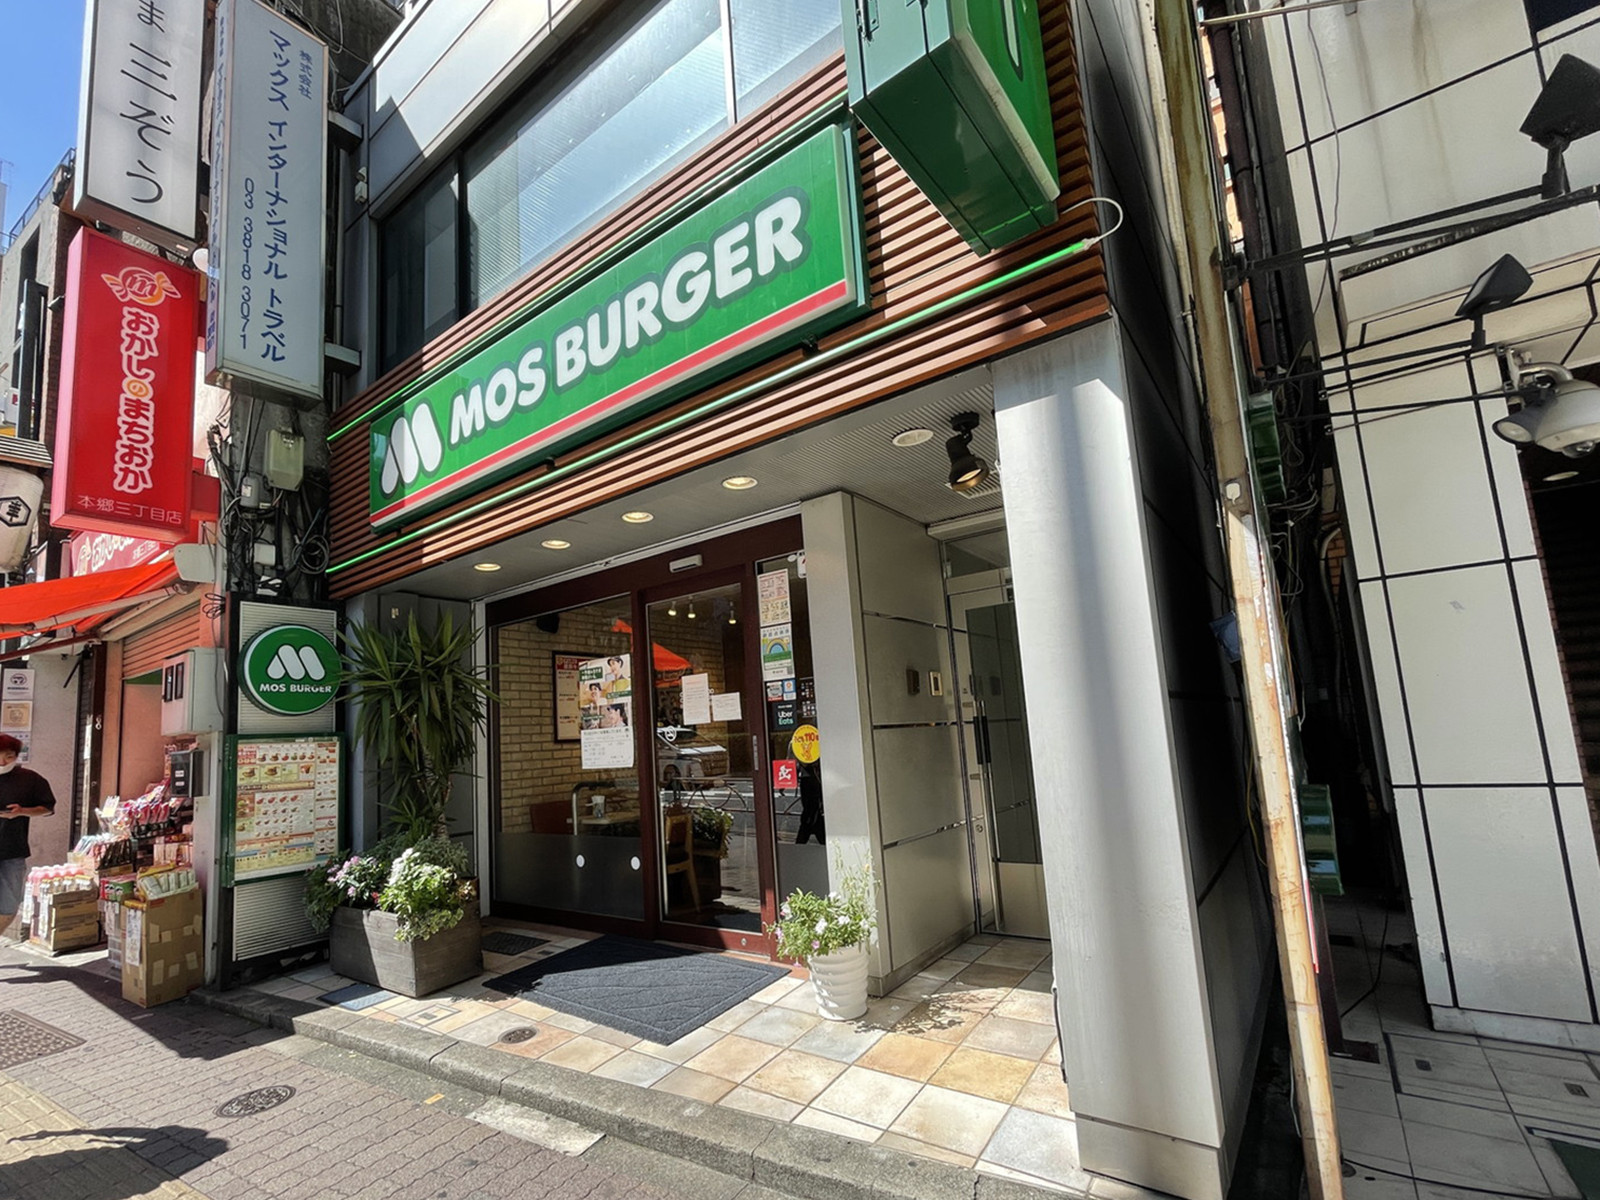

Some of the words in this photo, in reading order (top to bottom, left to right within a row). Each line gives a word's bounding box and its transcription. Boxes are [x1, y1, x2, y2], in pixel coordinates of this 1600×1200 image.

[120, 0, 178, 204] ま三ぞう
[268, 30, 291, 111] マックス
[298, 50, 313, 100] 株式会社
[244, 177, 255, 209] 03
[264, 120, 288, 280] インターナショナル
[241, 217, 253, 281] 3818
[240, 285, 252, 350] 3071
[261, 288, 286, 362] トラベル
[449, 347, 547, 445] MOS
[555, 196, 804, 387] BURGER
[114, 307, 159, 493] おかしのまちおか
[78, 494, 182, 524] 本郷三丁目店
[259, 683, 286, 692] MOS
[290, 684, 332, 693] BURGER
[778, 717, 794, 725] Eats
